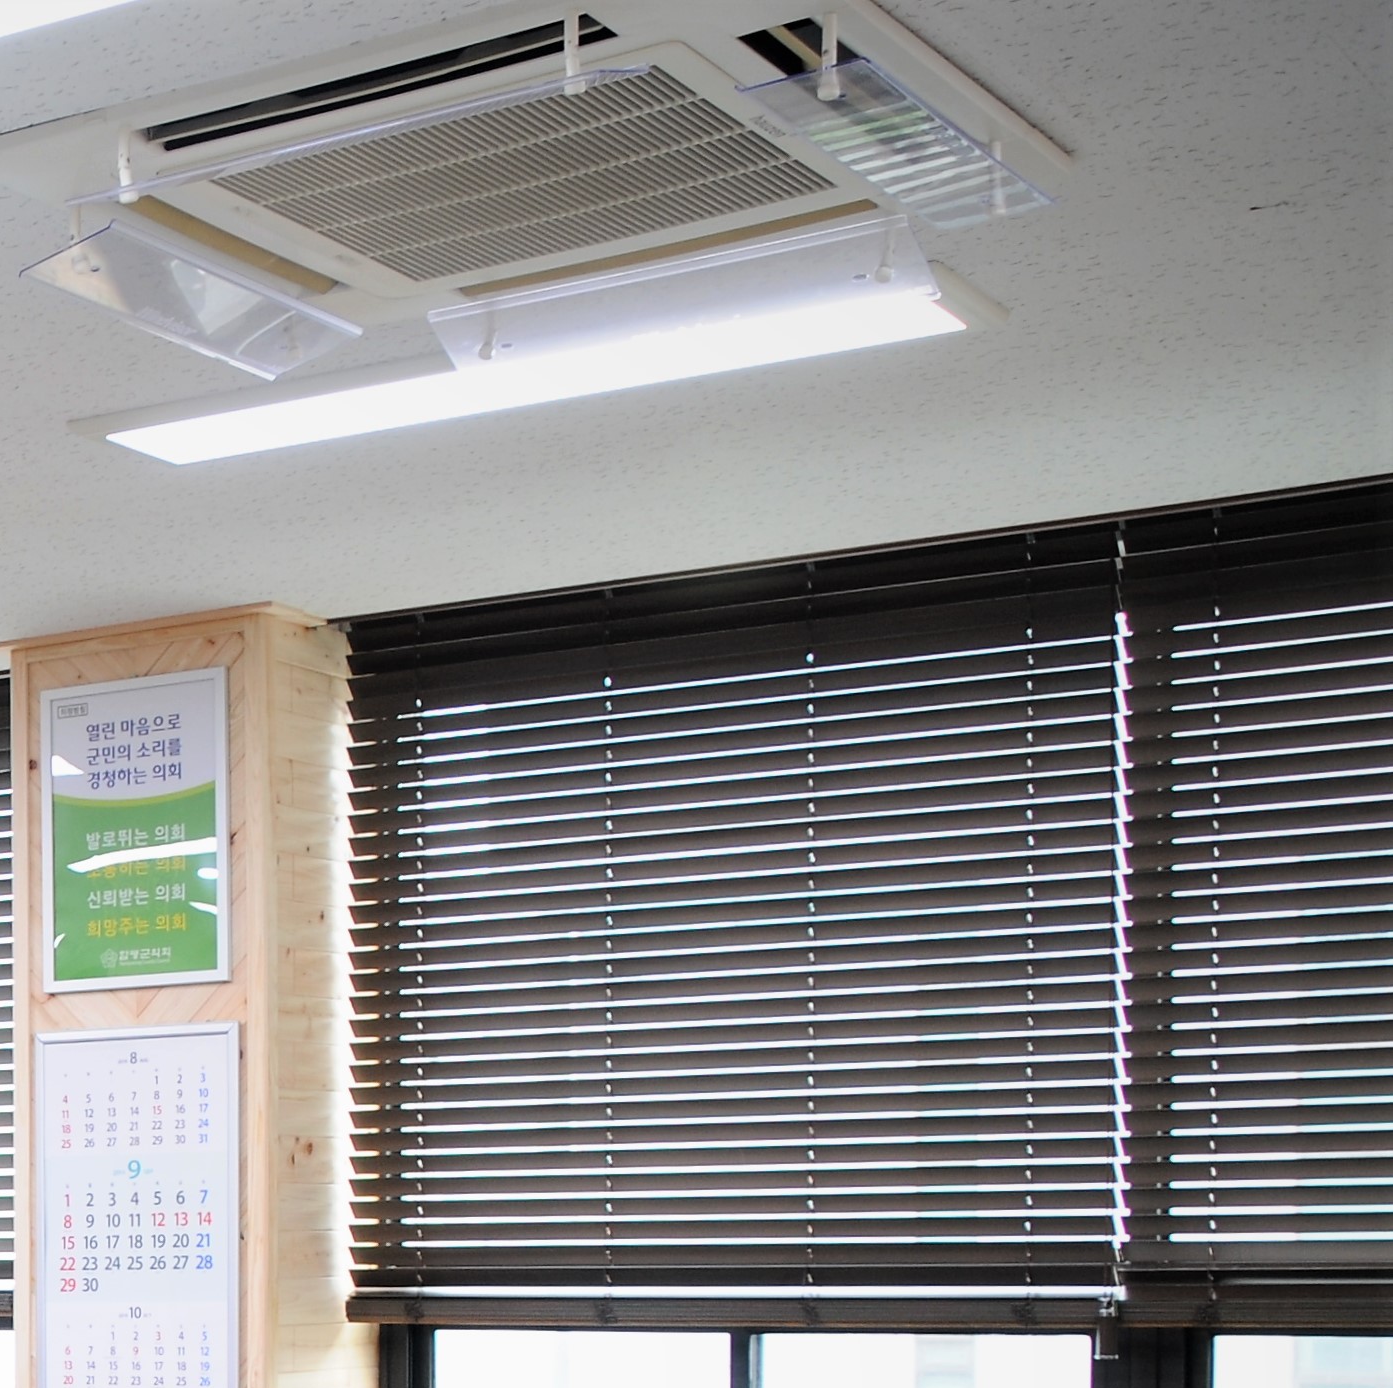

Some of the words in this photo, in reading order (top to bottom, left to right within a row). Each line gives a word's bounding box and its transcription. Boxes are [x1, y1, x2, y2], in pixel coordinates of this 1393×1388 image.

[86, 721, 116, 742] 열린
[120, 713, 182, 737] 마음으로
[86, 743, 132, 766] 군민의
[136, 738, 182, 758] 소리를
[87, 767, 148, 790] 경청하는
[152, 762, 182, 781] 의회
[86, 828, 149, 851] 발로뛰는
[154, 823, 186, 842] 의회
[87, 887, 150, 909] 신뢰받는
[155, 882, 186, 902] 의회
[87, 916, 150, 938] 희망주는
[155, 912, 187, 932] 의회
[130, 1052, 137, 1064] 8
[154, 1075, 159, 1084] 1
[176, 1074, 183, 1084] 2
[200, 1073, 207, 1083] 3
[62, 1094, 69, 1104] 4
[85, 1094, 92, 1103] 5
[108, 1093, 115, 1102] 6
[131, 1091, 137, 1101] 7
[153, 1091, 161, 1100] 8
[176, 1089, 183, 1099] 9
[199, 1088, 208, 1098] 10
[62, 1110, 69, 1119] 11
[85, 1108, 94, 1118] 12
[107, 1107, 116, 1117] 13
[130, 1107, 139, 1116] 14
[153, 1105, 162, 1115] 15
[176, 1104, 186, 1114] 16
[199, 1103, 209, 1113] 17
[62, 1124, 71, 1134] 18
[85, 1123, 94, 1132] 19
[107, 1122, 117, 1132] 20
[129, 1121, 138, 1131] 21
[152, 1120, 162, 1130] 22
[175, 1119, 185, 1129] 23
[198, 1119, 209, 1128] 24
[62, 1139, 71, 1148] 25
[84, 1138, 95, 1148] 26
[107, 1137, 117, 1147] 27
[129, 1136, 140, 1146] 28
[152, 1136, 163, 1145] 29
[175, 1135, 186, 1144] 30
[199, 1134, 208, 1143] 31
[128, 1160, 141, 1179] 9
[64, 1194, 71, 1207] 1
[86, 1193, 94, 1207] 2
[109, 1192, 116, 1206] 3
[131, 1192, 139, 1205] 4
[154, 1191, 161, 1205] 5
[176, 1191, 185, 1204] 6
[200, 1189, 208, 1204] 7
[64, 1215, 72, 1228] 8
[86, 1214, 94, 1228] 9
[106, 1214, 120, 1227] 10
[129, 1213, 140, 1227] 11
[151, 1213, 165, 1226] 12
[174, 1212, 188, 1226] 13
[198, 1212, 212, 1225] 14
[62, 1236, 75, 1249] 15
[84, 1235, 98, 1249] 16
[106, 1235, 119, 1248] 17
[129, 1235, 143, 1248] 18
[151, 1234, 166, 1248] 19
[173, 1234, 189, 1248] 20
[196, 1233, 210, 1248] 21
[60, 1257, 75, 1271] 22
[82, 1257, 98, 1270] 23
[105, 1256, 120, 1270] 24
[127, 1256, 143, 1270] 25
[150, 1256, 166, 1270] 26
[173, 1255, 188, 1269] 27
[196, 1255, 213, 1269] 28
[60, 1278, 76, 1292] 29
[82, 1278, 98, 1292] 30
[130, 1307, 141, 1318] 10
[110, 1331, 115, 1340] 1
[133, 1331, 139, 1341] 2
[155, 1331, 162, 1341] 3
[178, 1331, 185, 1341] 4
[201, 1331, 208, 1341] 5
[64, 1346, 72, 1355] 6
[87, 1346, 94, 1355] 7
[109, 1346, 117, 1355] 8
[132, 1346, 140, 1356] 9
[155, 1346, 164, 1355] 10
[178, 1347, 185, 1356] 11
[201, 1346, 209, 1356] 12
[64, 1361, 73, 1370] 13
[87, 1360, 95, 1370] 14
[109, 1361, 118, 1370] 15
[132, 1361, 141, 1370] 16
[155, 1361, 164, 1370] 17
[177, 1361, 186, 1371] 18
[200, 1361, 210, 1371] 19
[63, 1375, 73, 1385] 20
[86, 1376, 94, 1385] 21
[109, 1376, 118, 1385] 22
[131, 1376, 141, 1385] 23
[154, 1376, 164, 1385] 24
[176, 1376, 186, 1386] 25
[200, 1377, 210, 1386] 26
